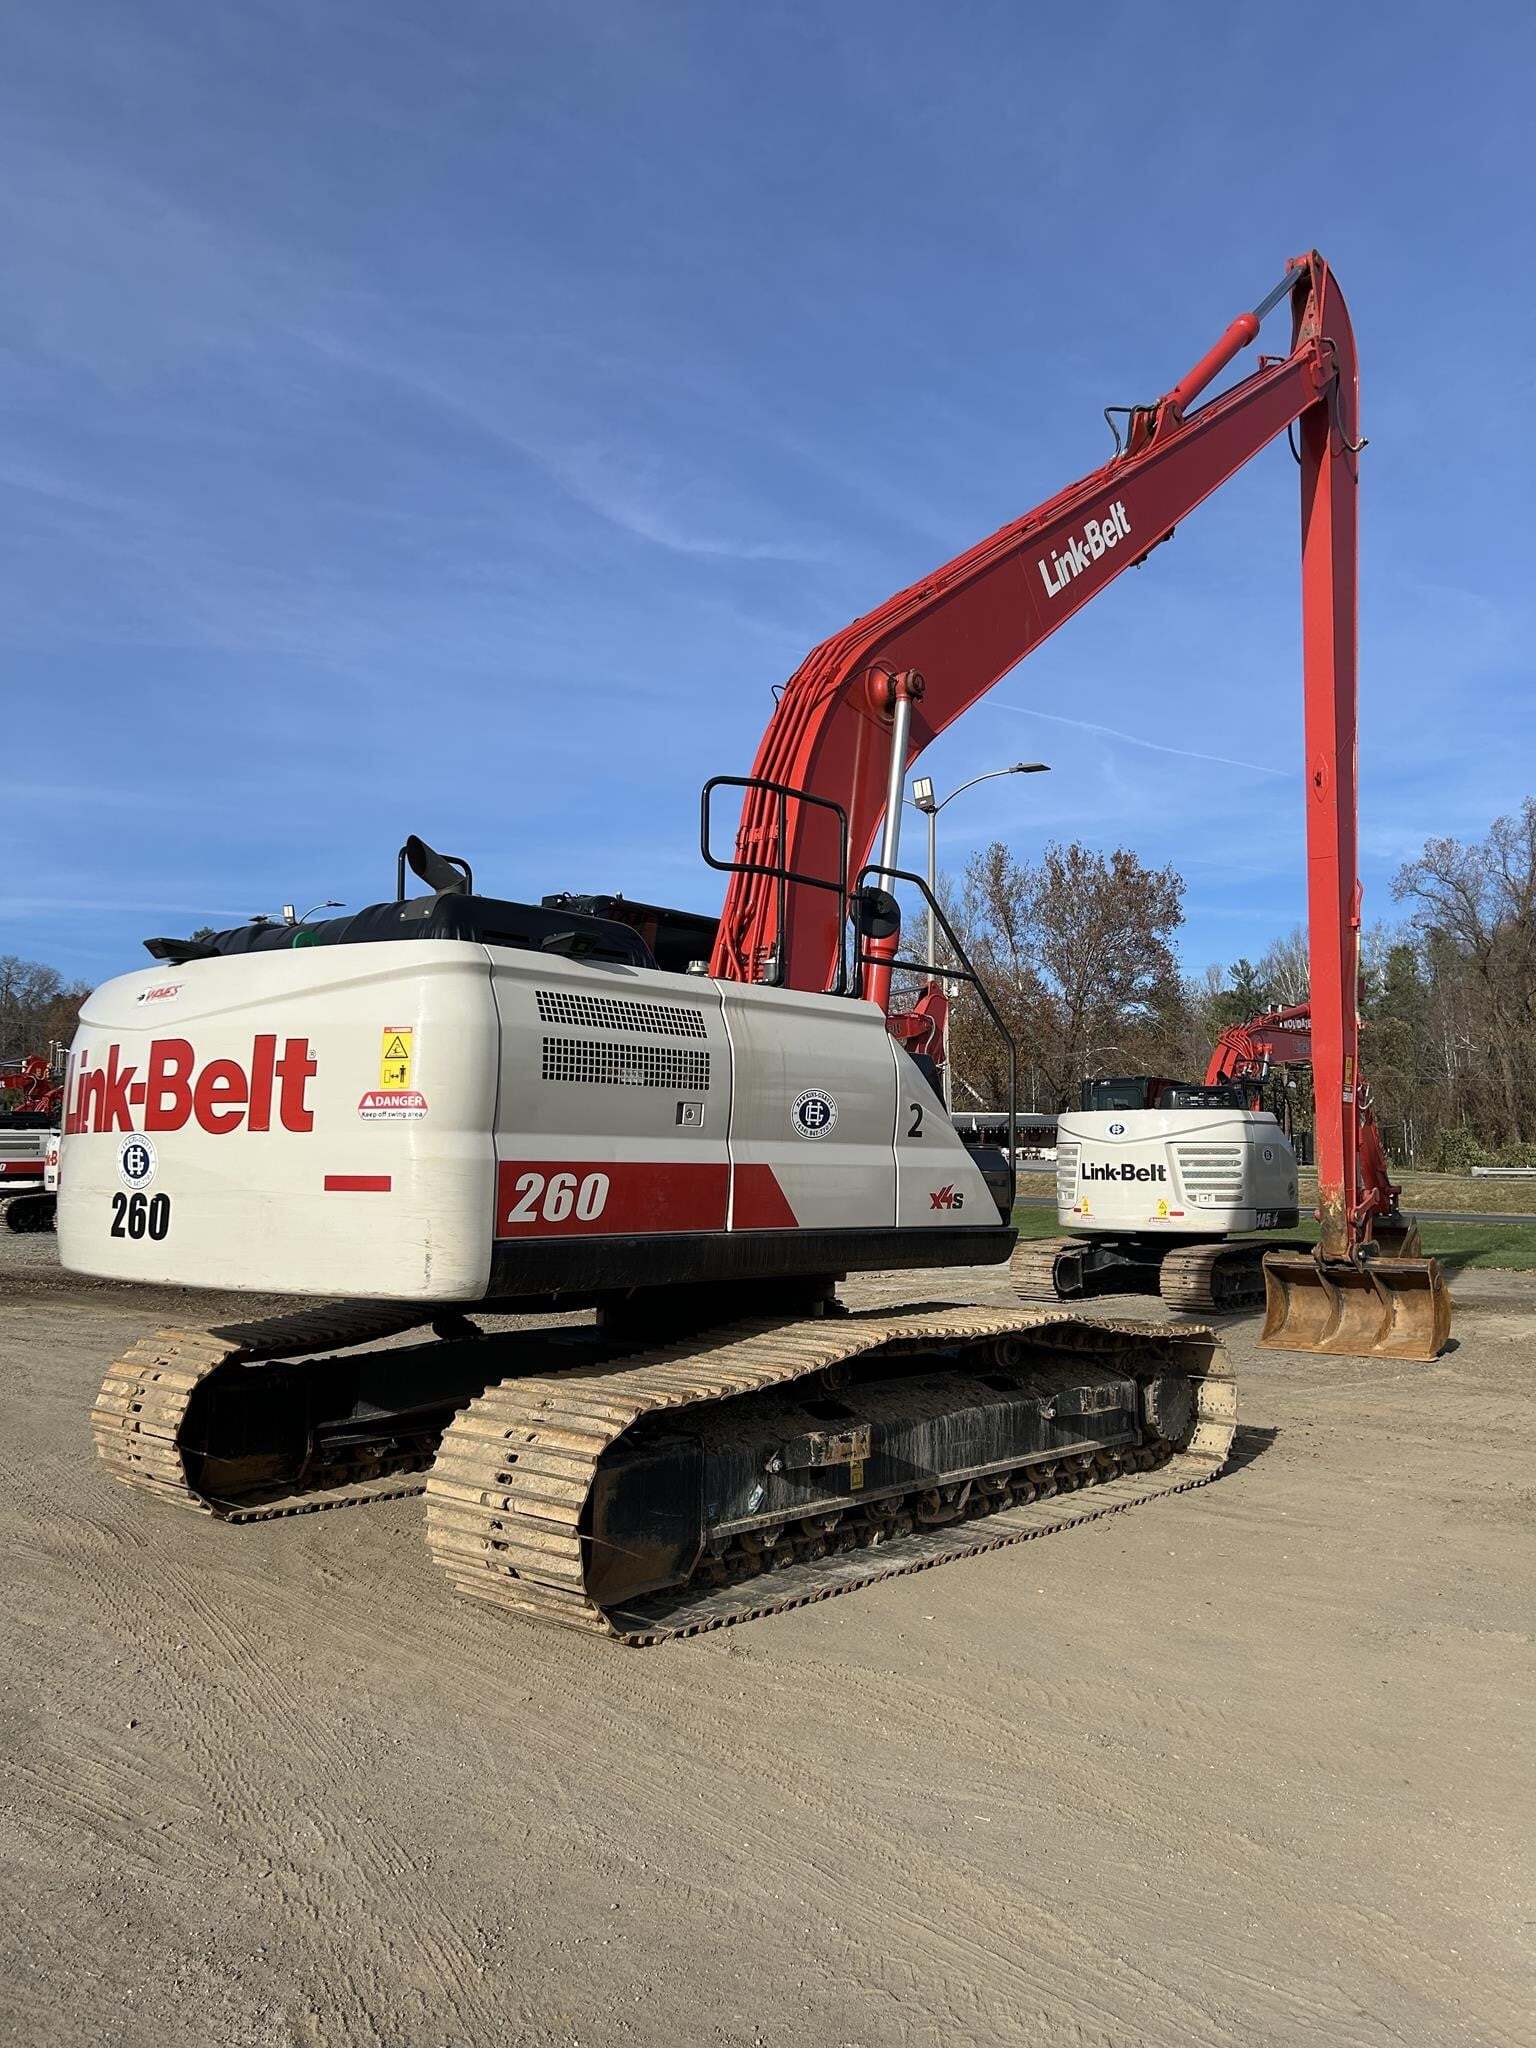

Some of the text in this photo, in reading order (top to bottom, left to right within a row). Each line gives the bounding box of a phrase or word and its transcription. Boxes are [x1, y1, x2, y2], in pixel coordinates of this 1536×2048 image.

[1037, 500, 1132, 598] Link-Belt
[65, 1034, 317, 1135] Link-Belt
[375, 1095, 422, 1107] DANGER
[907, 1102, 924, 1138] 2
[1081, 1162, 1167, 1181] Link-Belt
[110, 1191, 171, 1241] 260
[507, 1172, 610, 1223] 260
